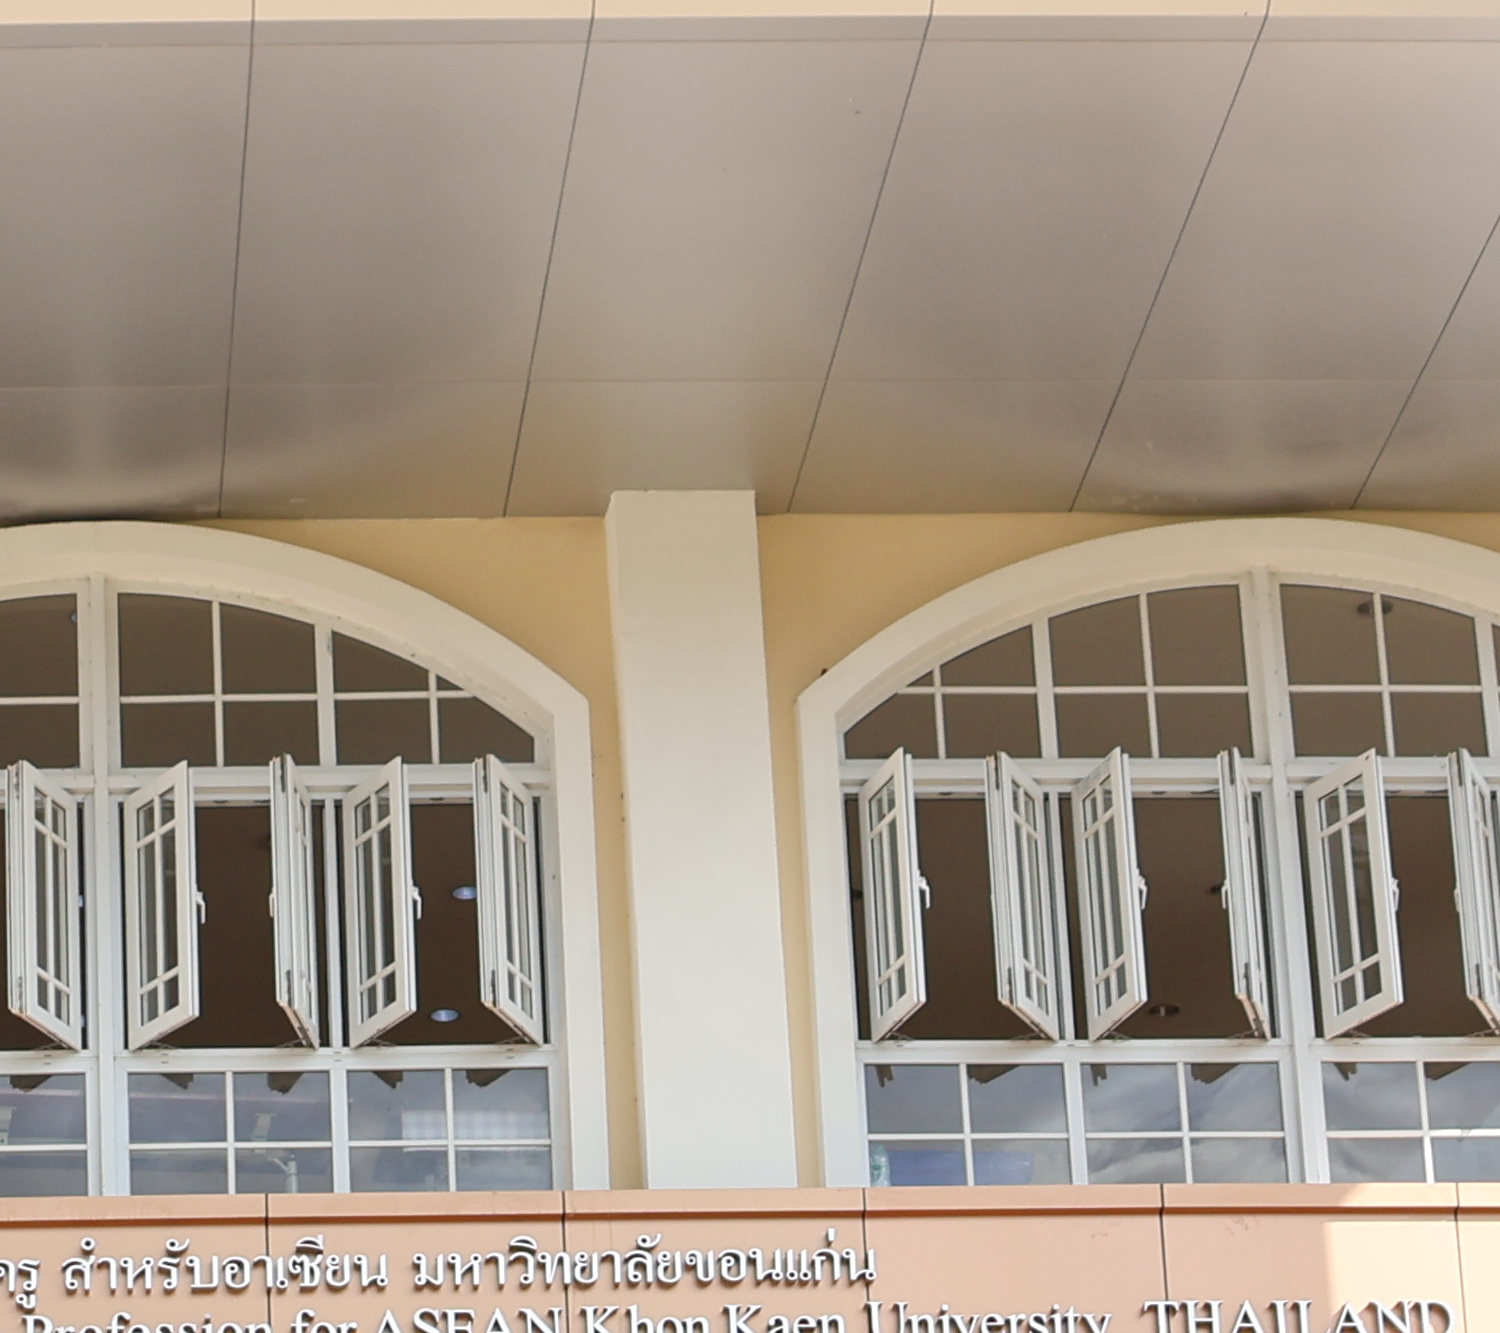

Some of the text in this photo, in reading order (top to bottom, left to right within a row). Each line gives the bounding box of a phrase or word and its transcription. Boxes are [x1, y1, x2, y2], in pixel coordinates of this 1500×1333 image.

[62, 1235, 389, 1292] สำหรับอาเซียน
[413, 1228, 877, 1289] มหาวิทยาลัยขอนแก่น
